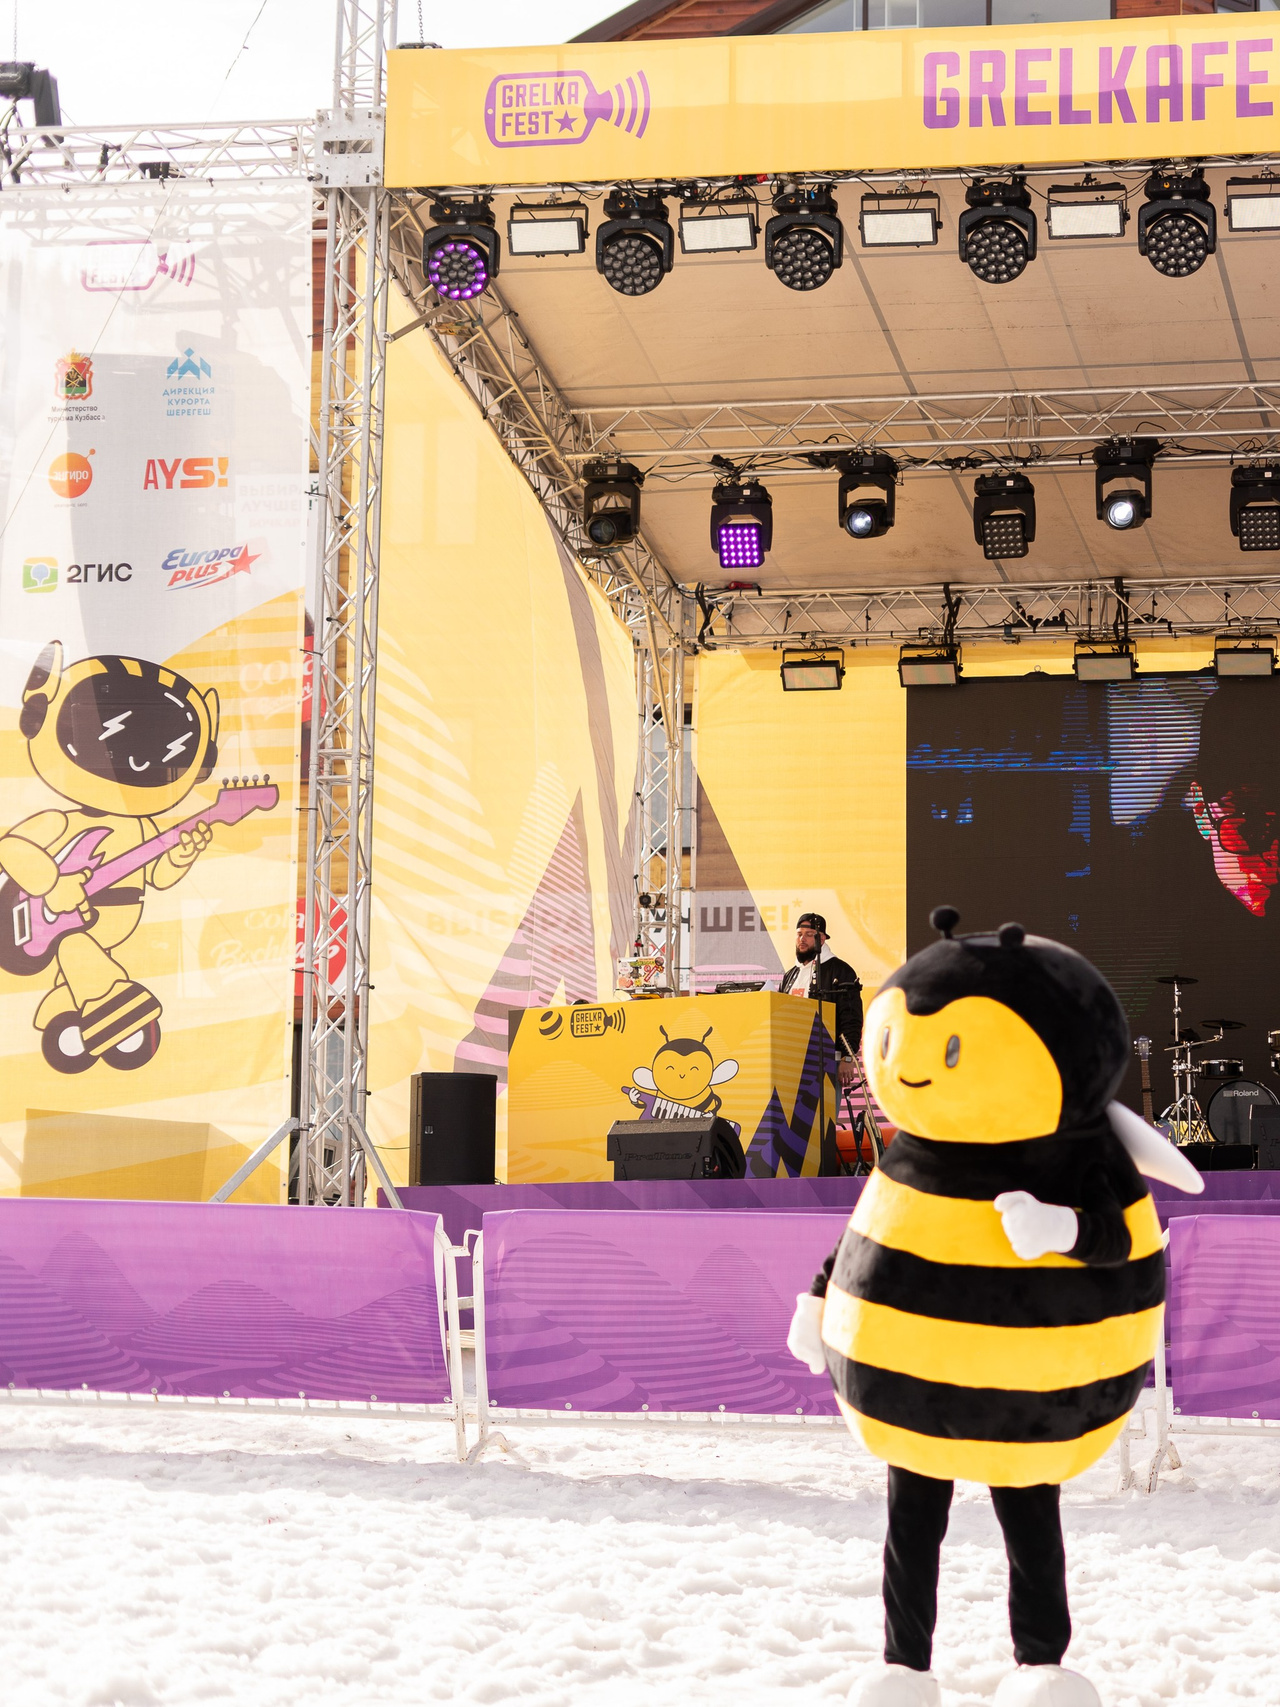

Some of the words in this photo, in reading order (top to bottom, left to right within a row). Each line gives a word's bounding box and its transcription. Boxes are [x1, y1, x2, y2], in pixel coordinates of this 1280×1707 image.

[501, 81, 579, 108] GRELKA
[501, 110, 554, 137] FEST
[162, 387, 215, 397] ДИРЕКЦИЯ
[167, 398, 211, 406] КУРОРТА
[51, 405, 98, 414] Министерство
[166, 408, 212, 417] ШЕРЕГЕШ
[143, 457, 230, 490] AYS!
[161, 546, 243, 571] Europa
[67, 562, 133, 584] 2ГИС
[576, 1012, 602, 1023] GRELKA
[576, 1023, 594, 1034] FEST
[1233, 1089, 1260, 1097] Roland
[624, 1152, 693, 1161] ProTone
